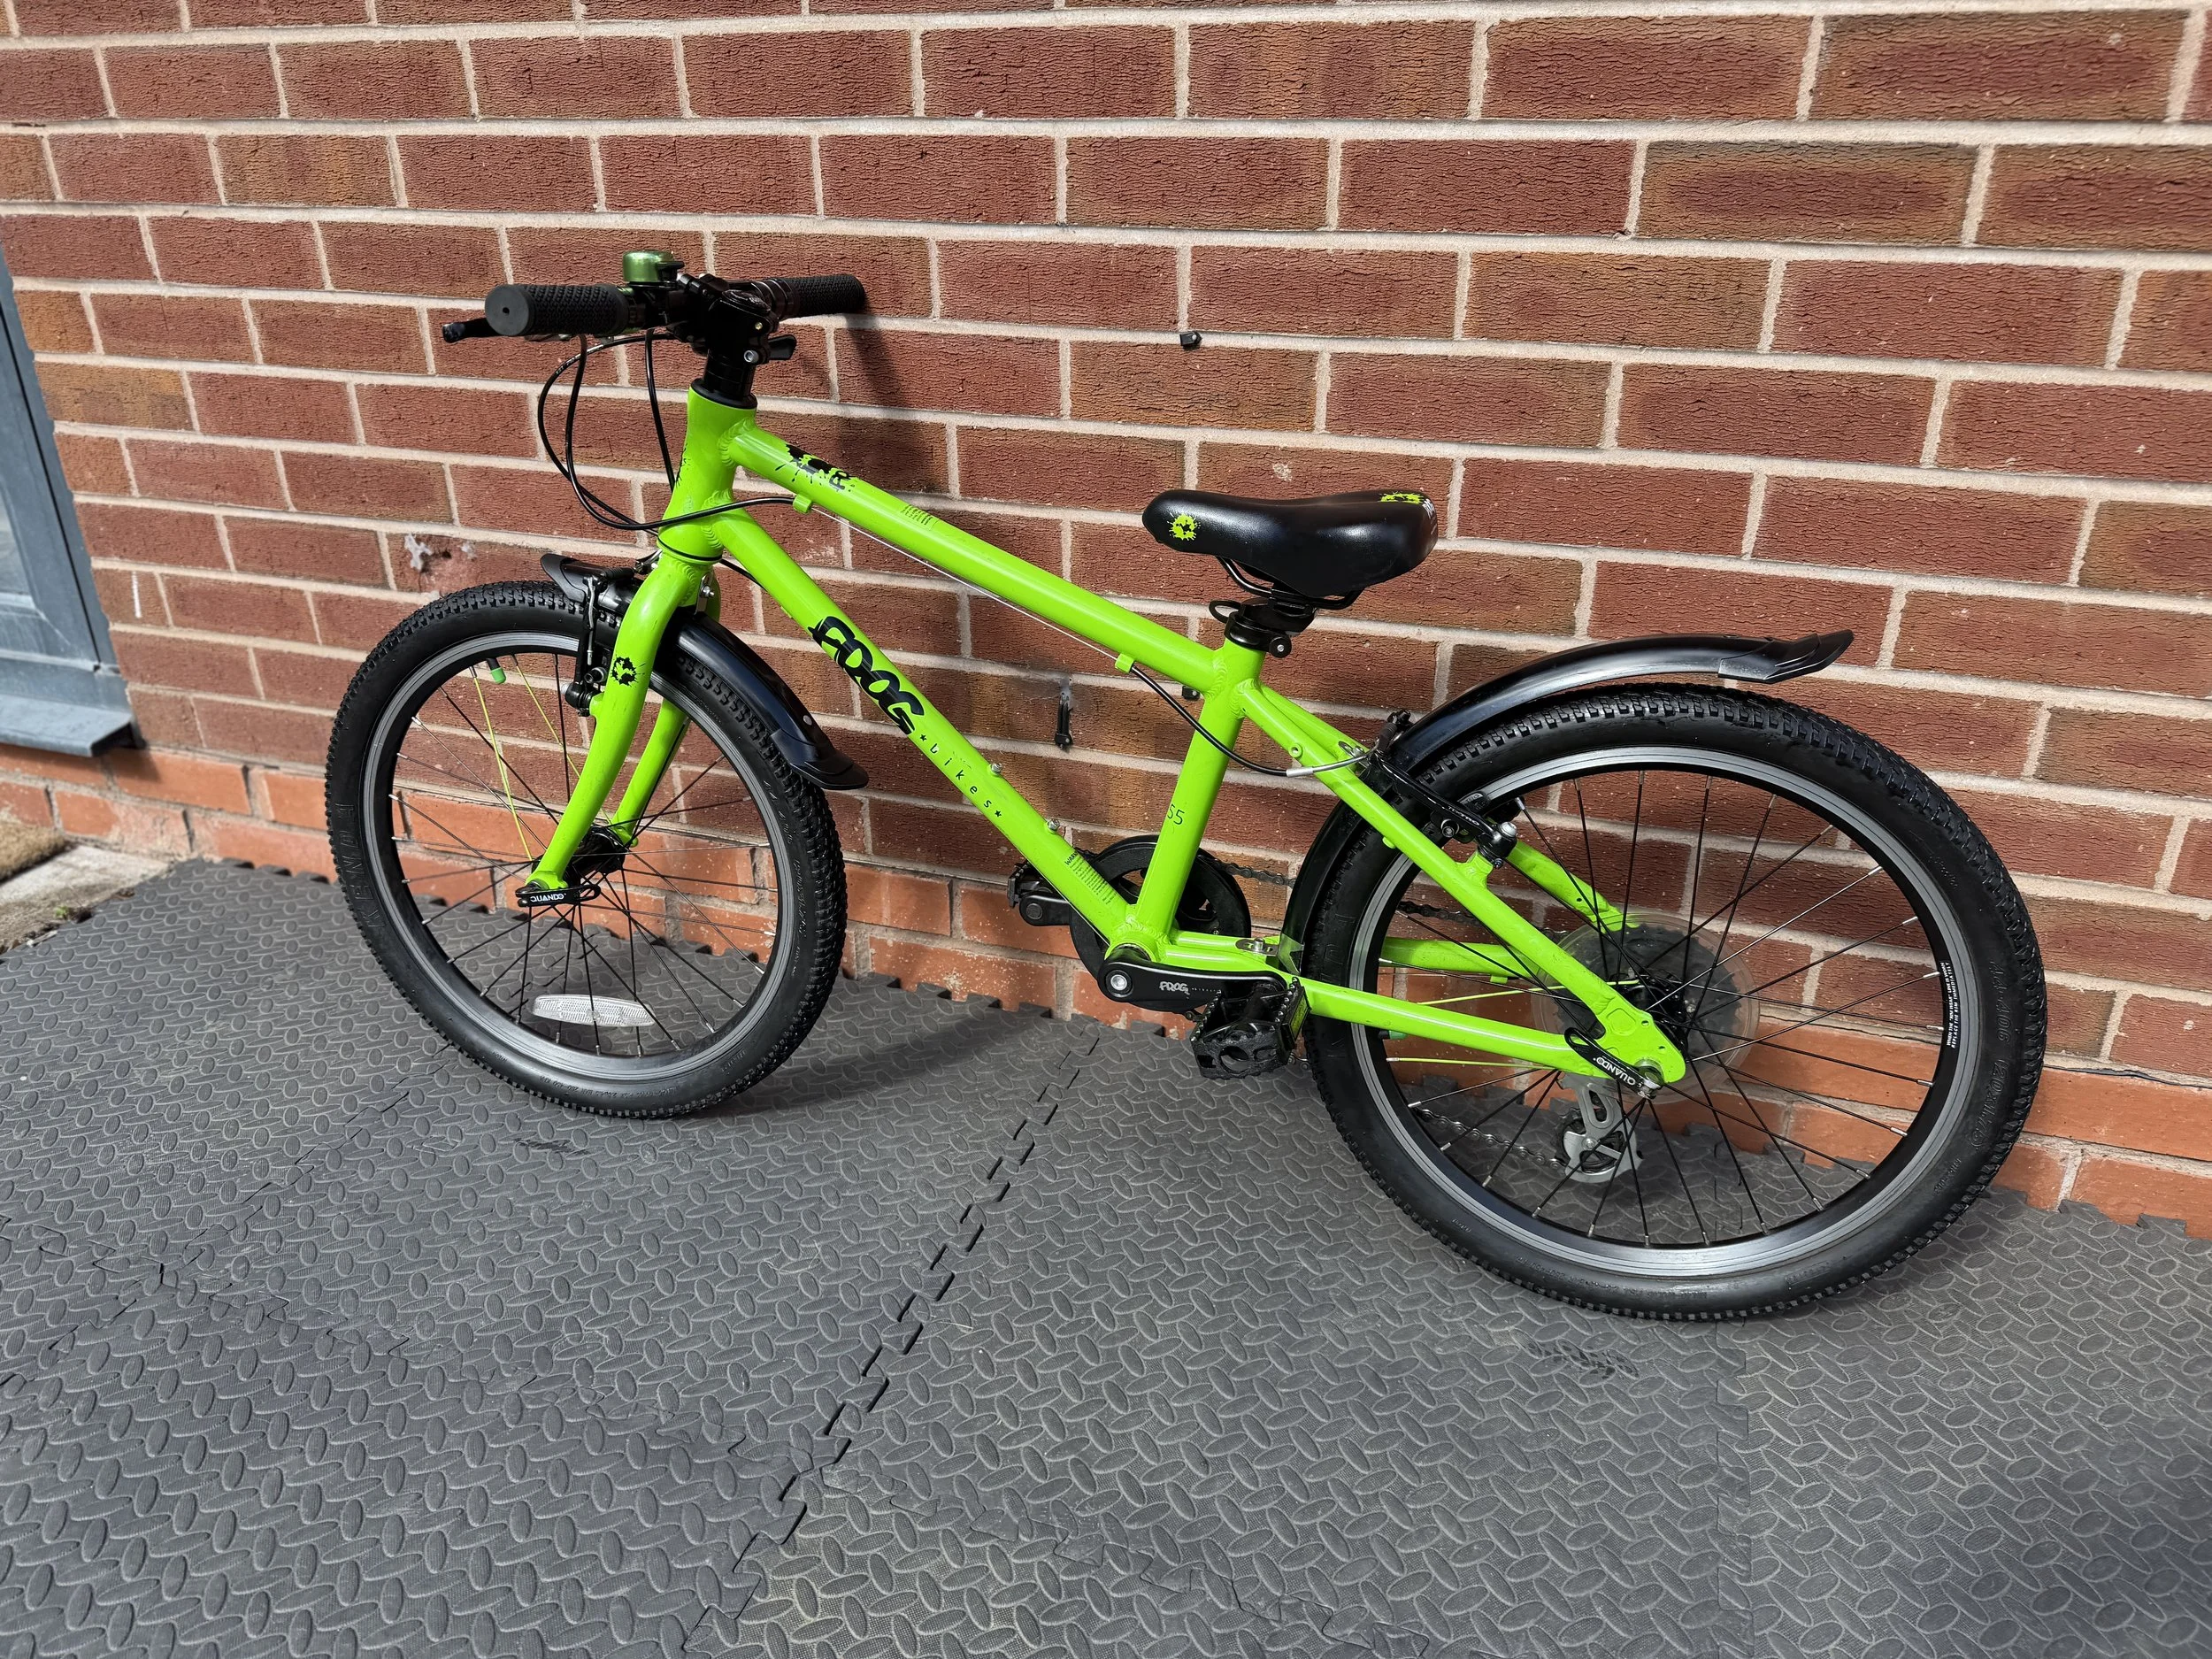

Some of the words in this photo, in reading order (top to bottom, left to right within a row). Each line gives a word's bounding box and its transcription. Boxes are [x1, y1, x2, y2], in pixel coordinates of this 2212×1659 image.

[807, 616, 925, 735] FROG
[929, 743, 992, 808] bikes
[1596, 1056, 1636, 1086] QUANDO
